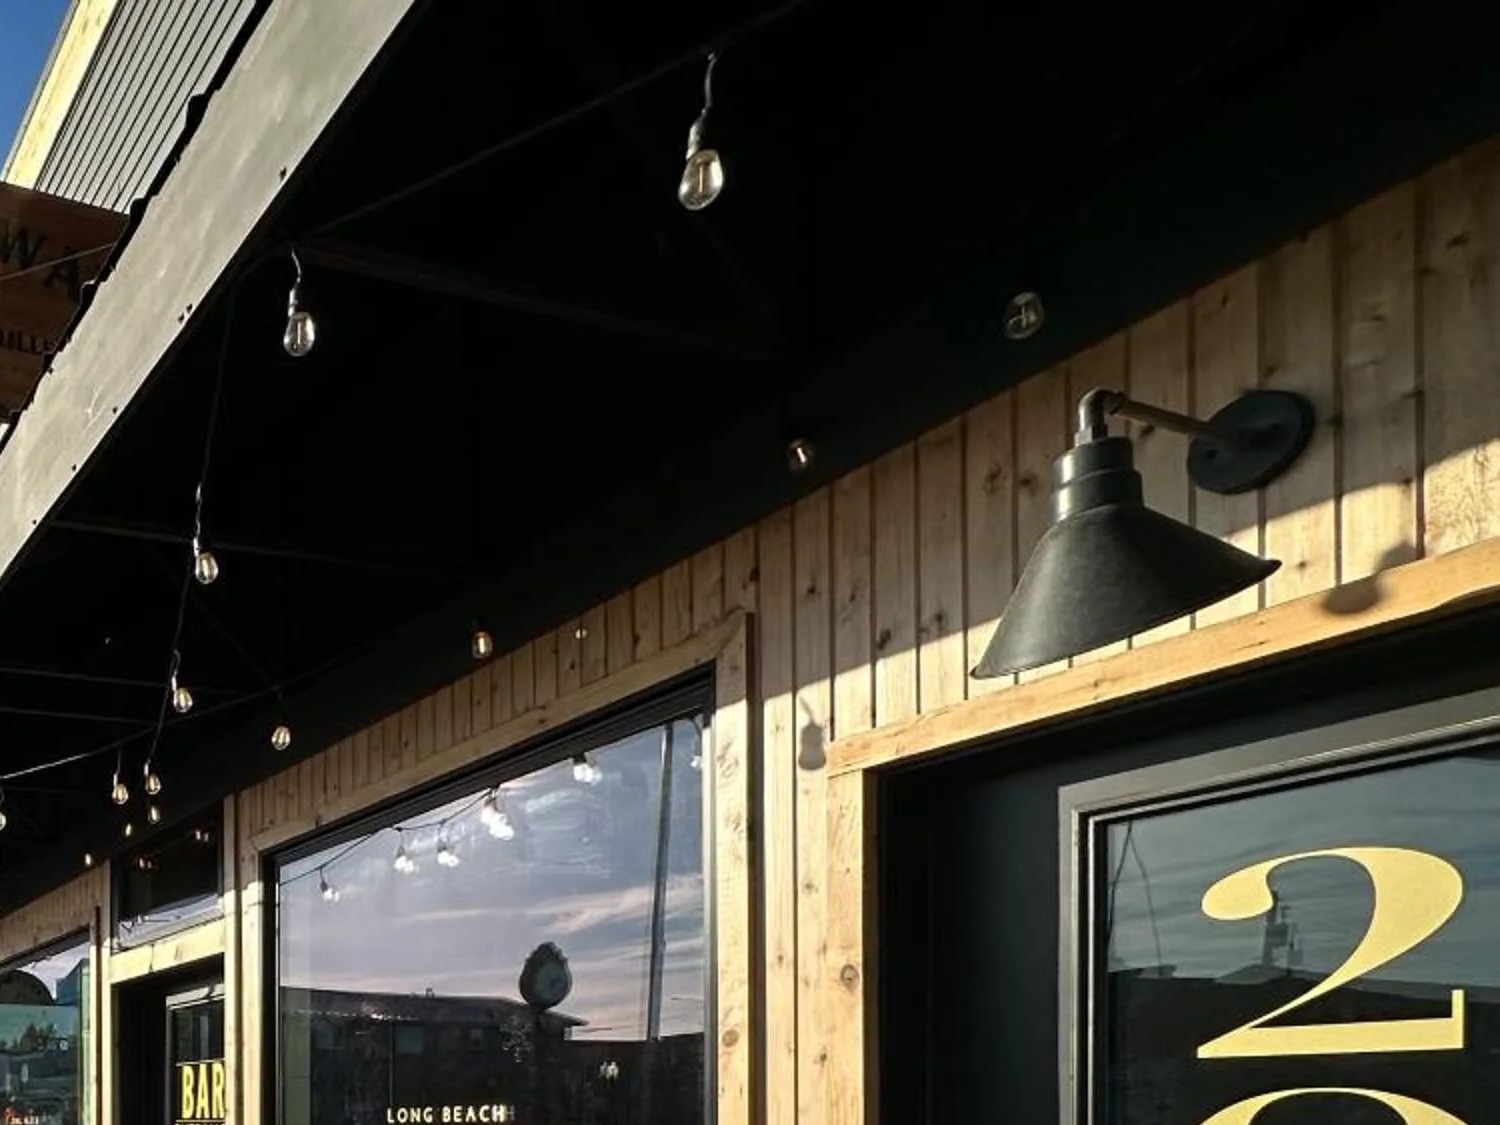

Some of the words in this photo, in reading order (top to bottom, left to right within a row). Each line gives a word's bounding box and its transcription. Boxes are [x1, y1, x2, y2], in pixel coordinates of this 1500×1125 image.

[181, 1062, 225, 1119] BAR
[387, 1107, 433, 1123] LONG
[441, 1104, 507, 1123] BEACH
